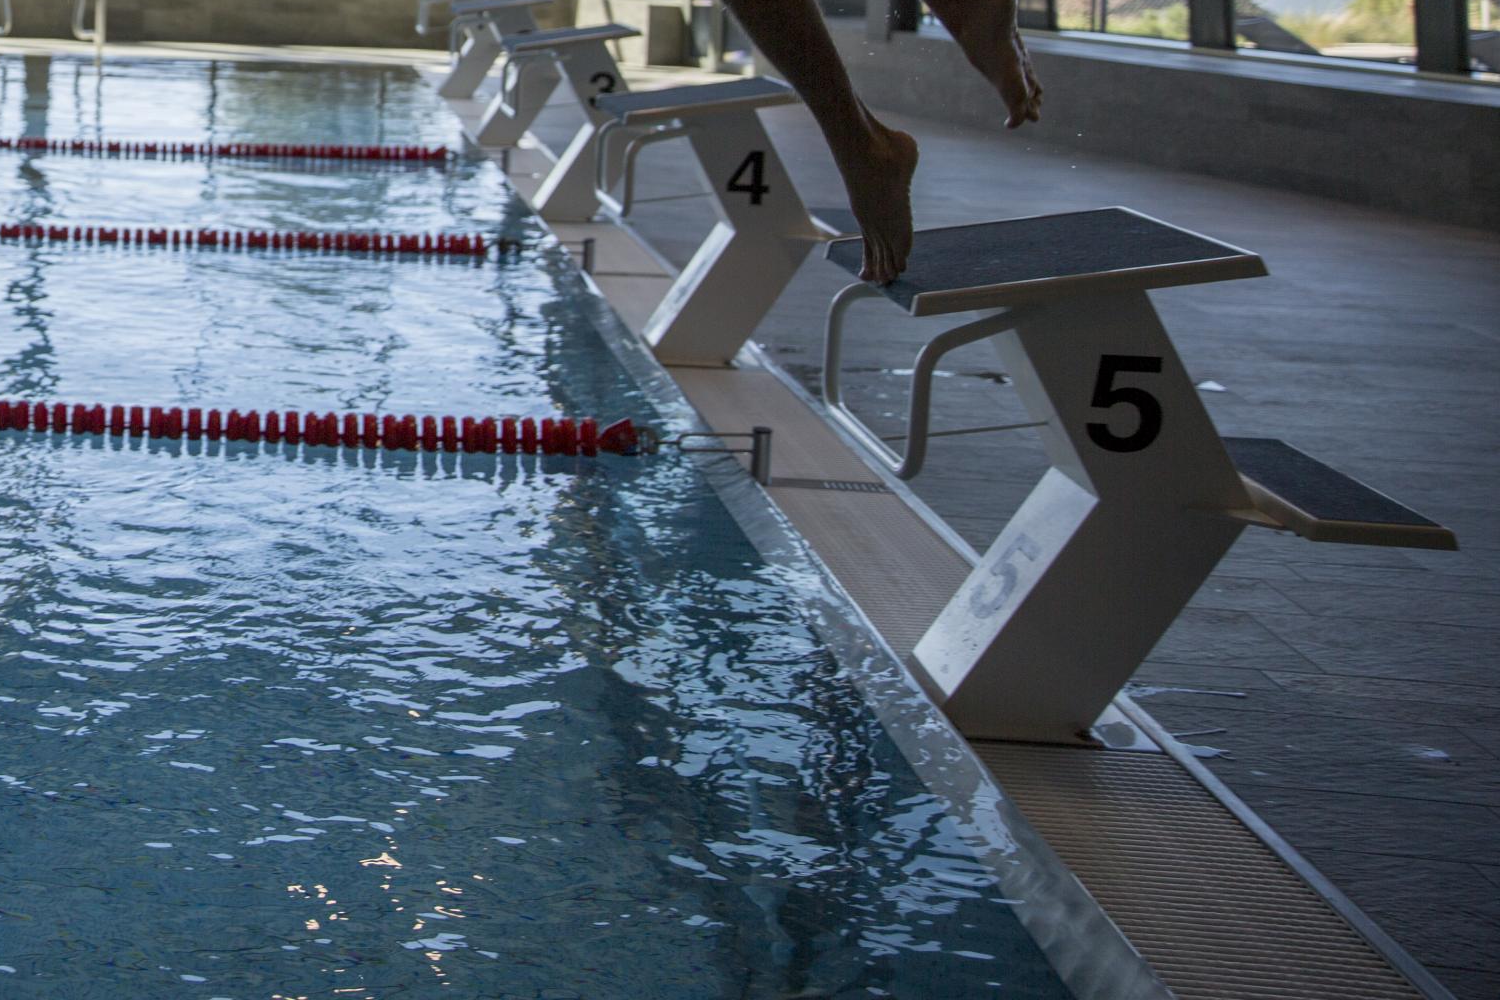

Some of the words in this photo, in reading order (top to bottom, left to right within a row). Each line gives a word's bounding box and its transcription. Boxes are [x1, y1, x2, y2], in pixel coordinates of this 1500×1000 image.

[727, 150, 769, 205] 4
[1086, 355, 1163, 452] 5
[969, 532, 1041, 619] 5
